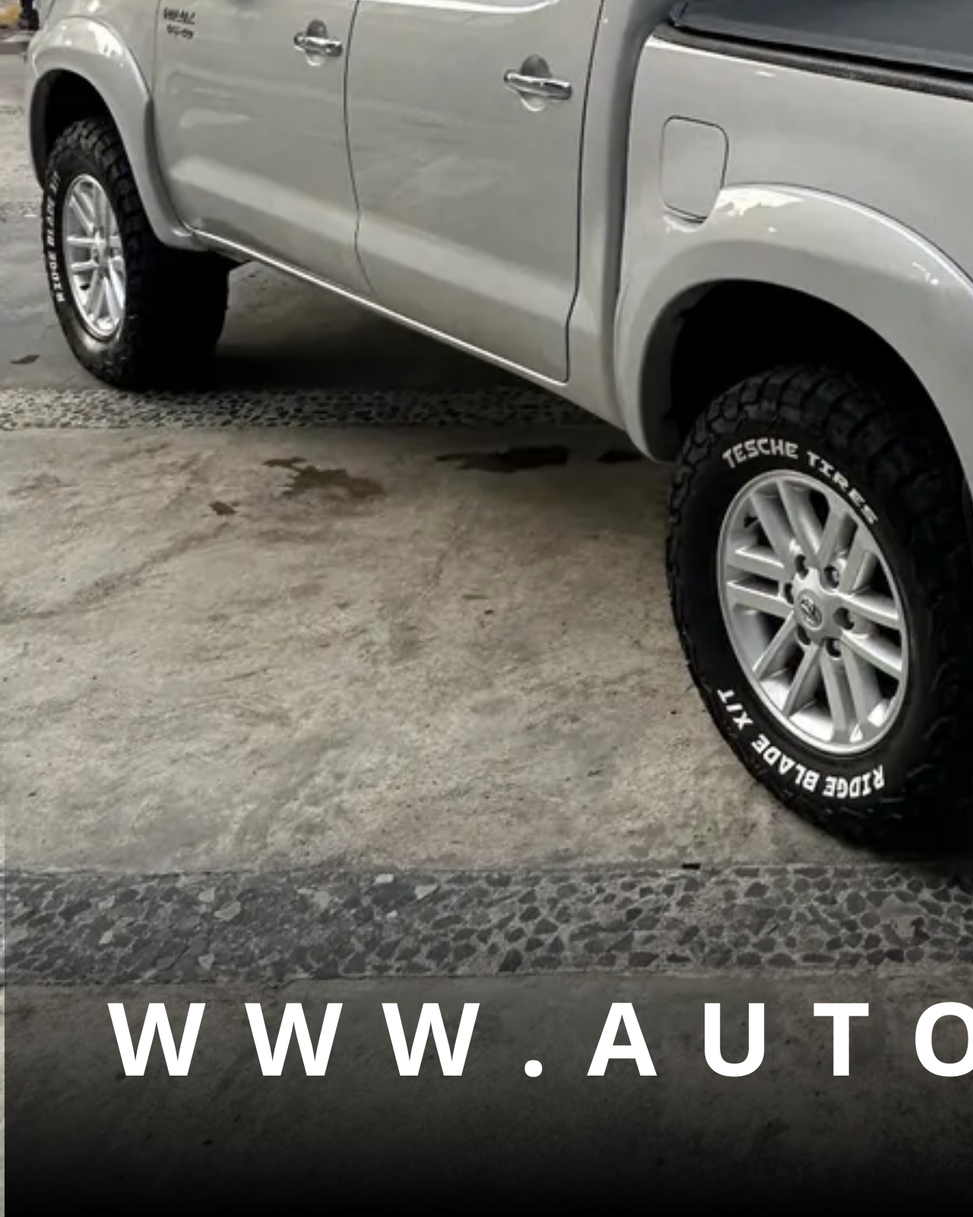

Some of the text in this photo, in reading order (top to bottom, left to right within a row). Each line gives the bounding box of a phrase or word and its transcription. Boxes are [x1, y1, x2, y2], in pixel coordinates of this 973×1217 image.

[721, 437, 879, 525] TESCHE TIRES
[750, 732, 822, 793] BLADE
[822, 763, 886, 800] RIDGE
